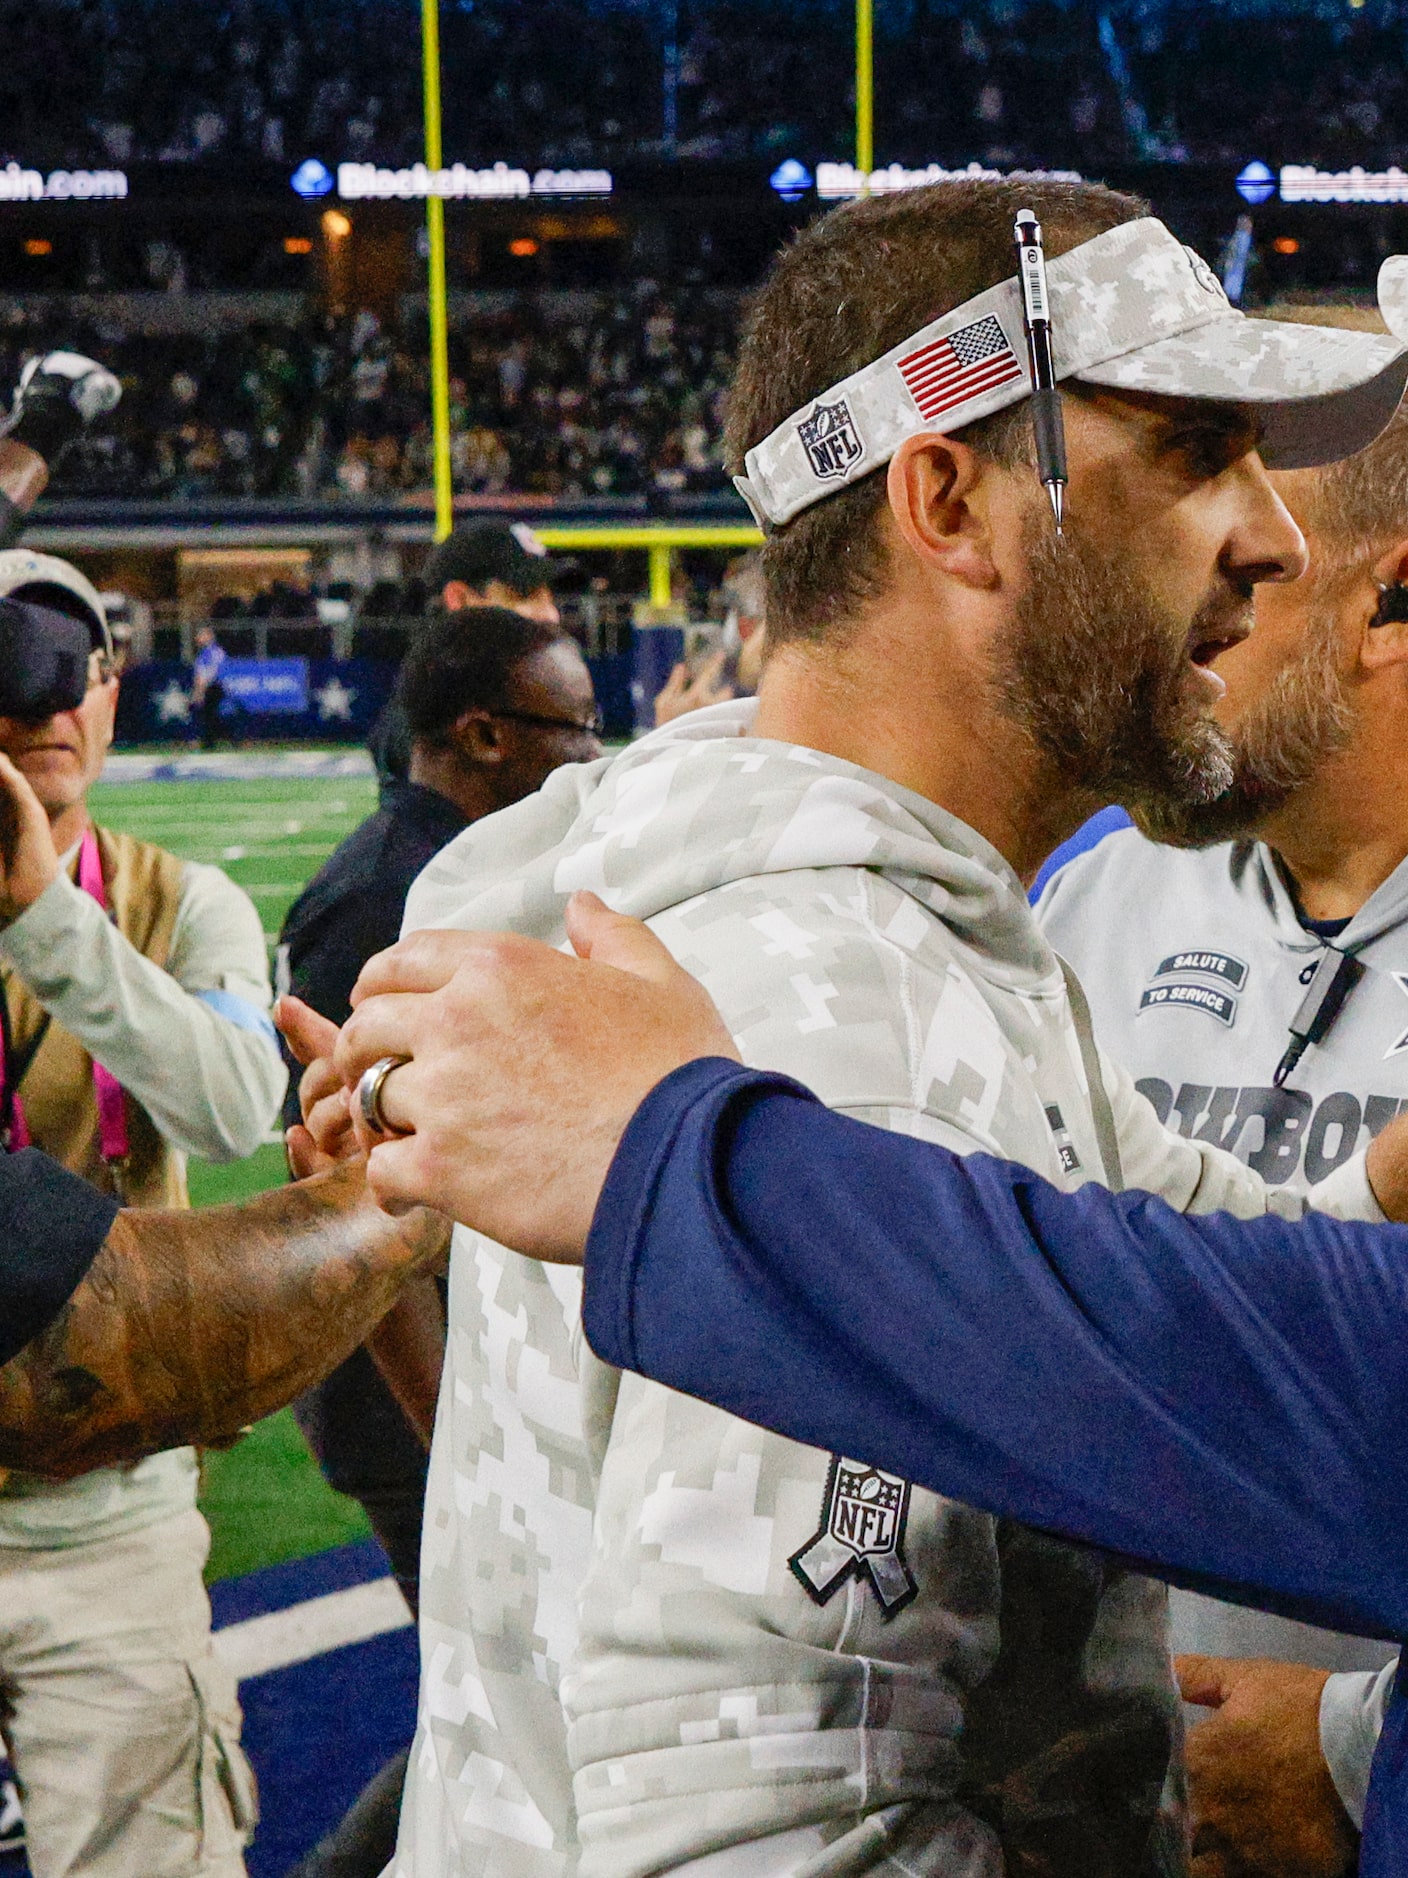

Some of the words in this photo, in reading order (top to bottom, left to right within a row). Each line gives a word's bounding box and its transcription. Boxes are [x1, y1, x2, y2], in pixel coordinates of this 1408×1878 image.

[811, 429, 858, 473] NFL
[1173, 953, 1227, 972] SALUTE
[1149, 990, 1167, 1004] TO
[1169, 986, 1225, 1012] SERVICE
[836, 1500, 890, 1548] NFL
